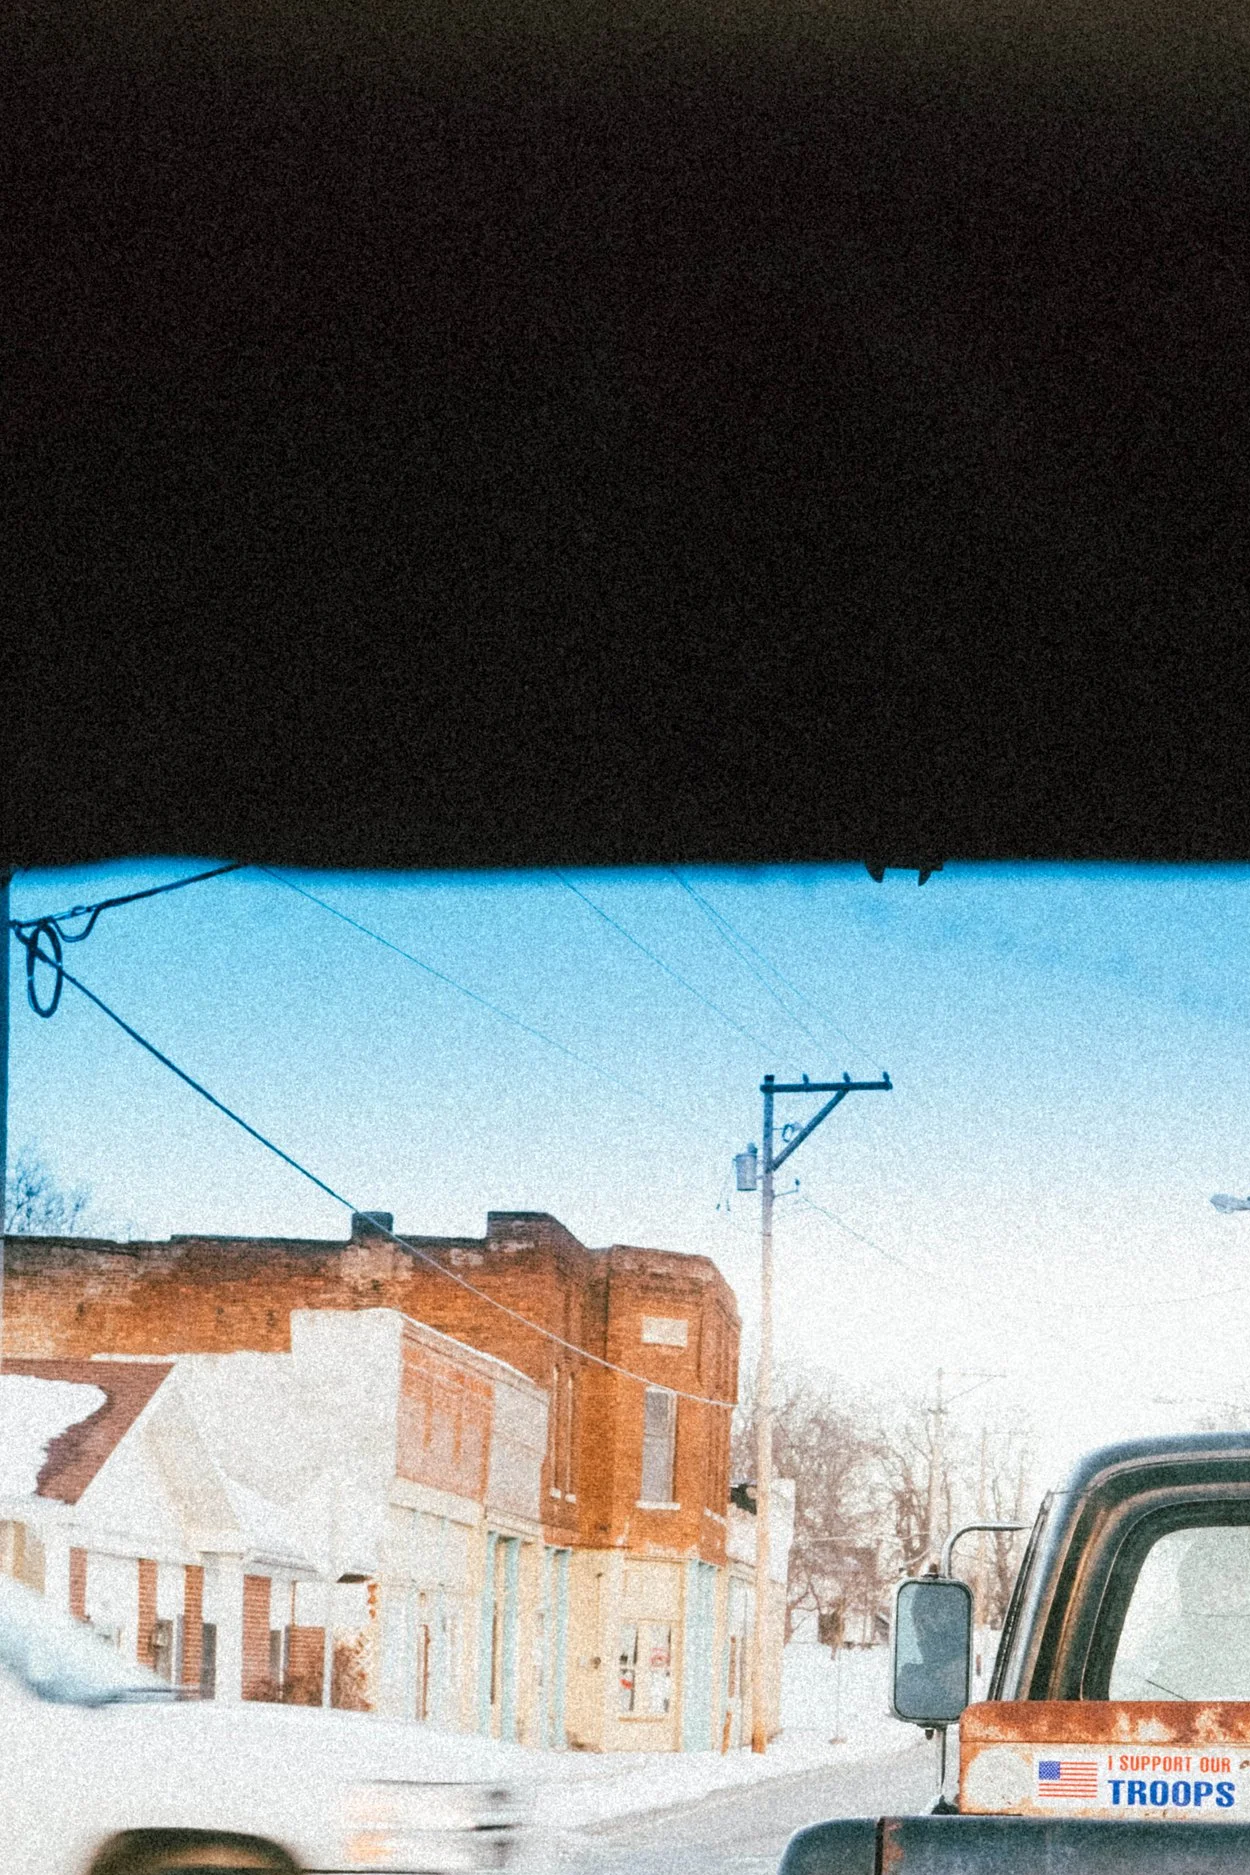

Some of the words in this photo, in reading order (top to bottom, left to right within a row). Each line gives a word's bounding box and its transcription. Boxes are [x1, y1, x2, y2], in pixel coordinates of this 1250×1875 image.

[1107, 1755, 1113, 1771] I
[1119, 1754, 1193, 1772] SUPPORT
[1200, 1756, 1232, 1773] OUR
[1107, 1779, 1236, 1808] TROOPS
